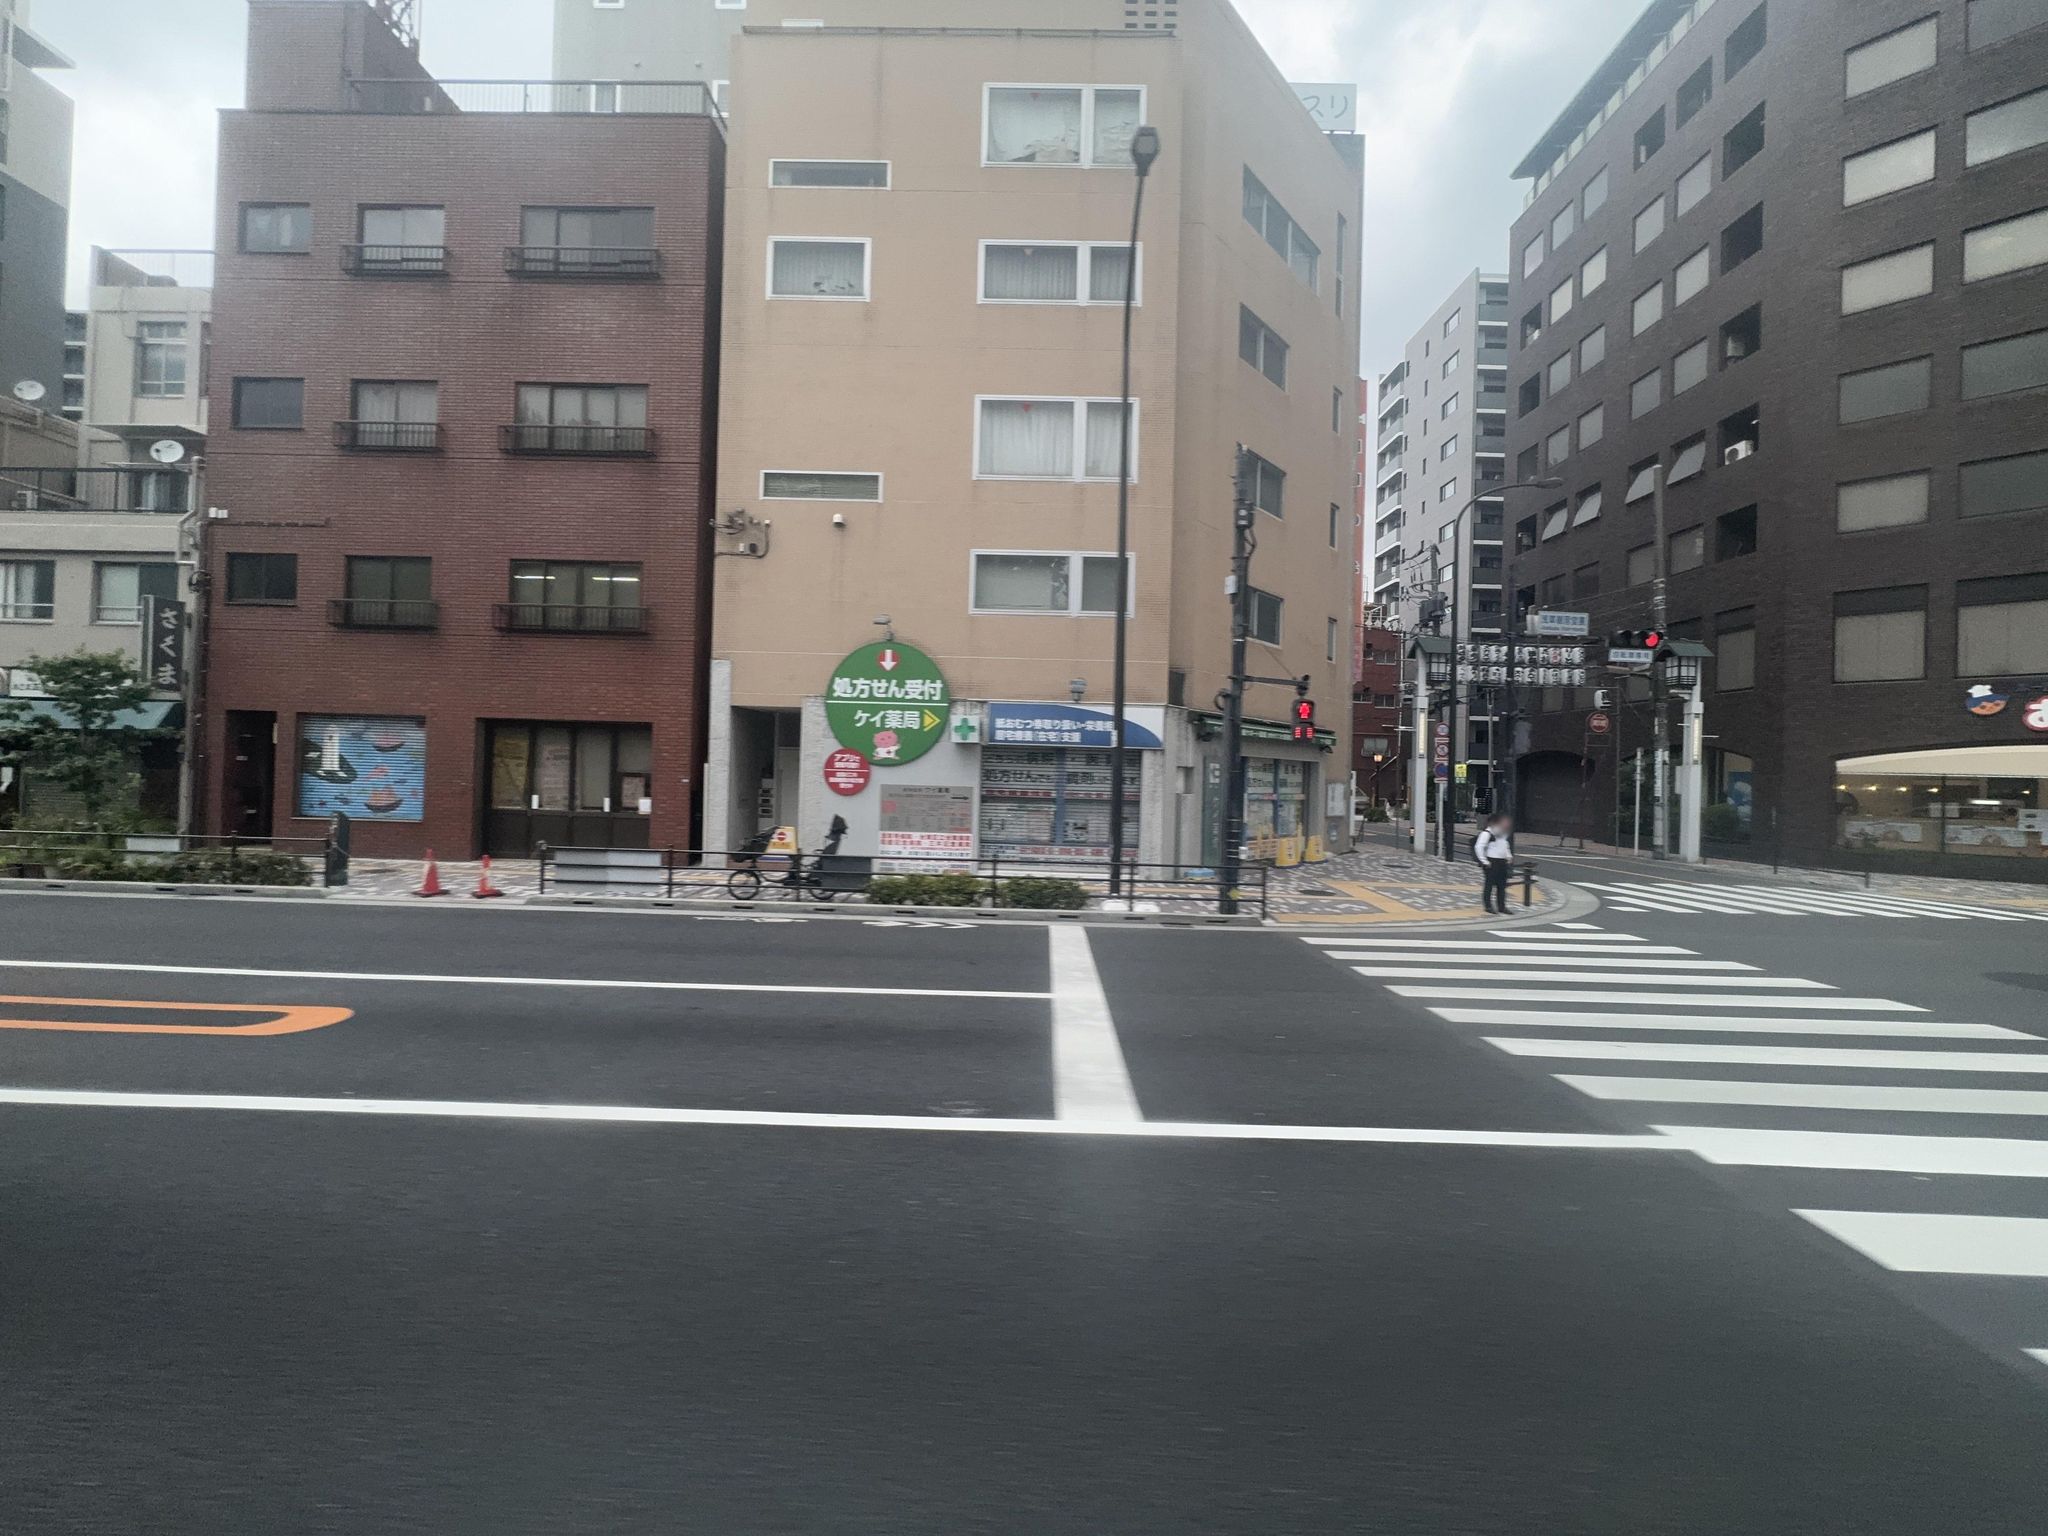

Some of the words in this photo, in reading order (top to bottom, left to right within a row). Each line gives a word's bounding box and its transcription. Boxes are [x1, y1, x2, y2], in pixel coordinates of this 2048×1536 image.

[832, 677, 943, 700] 処方せん受付
[854, 709, 920, 730] ケイ薬局
